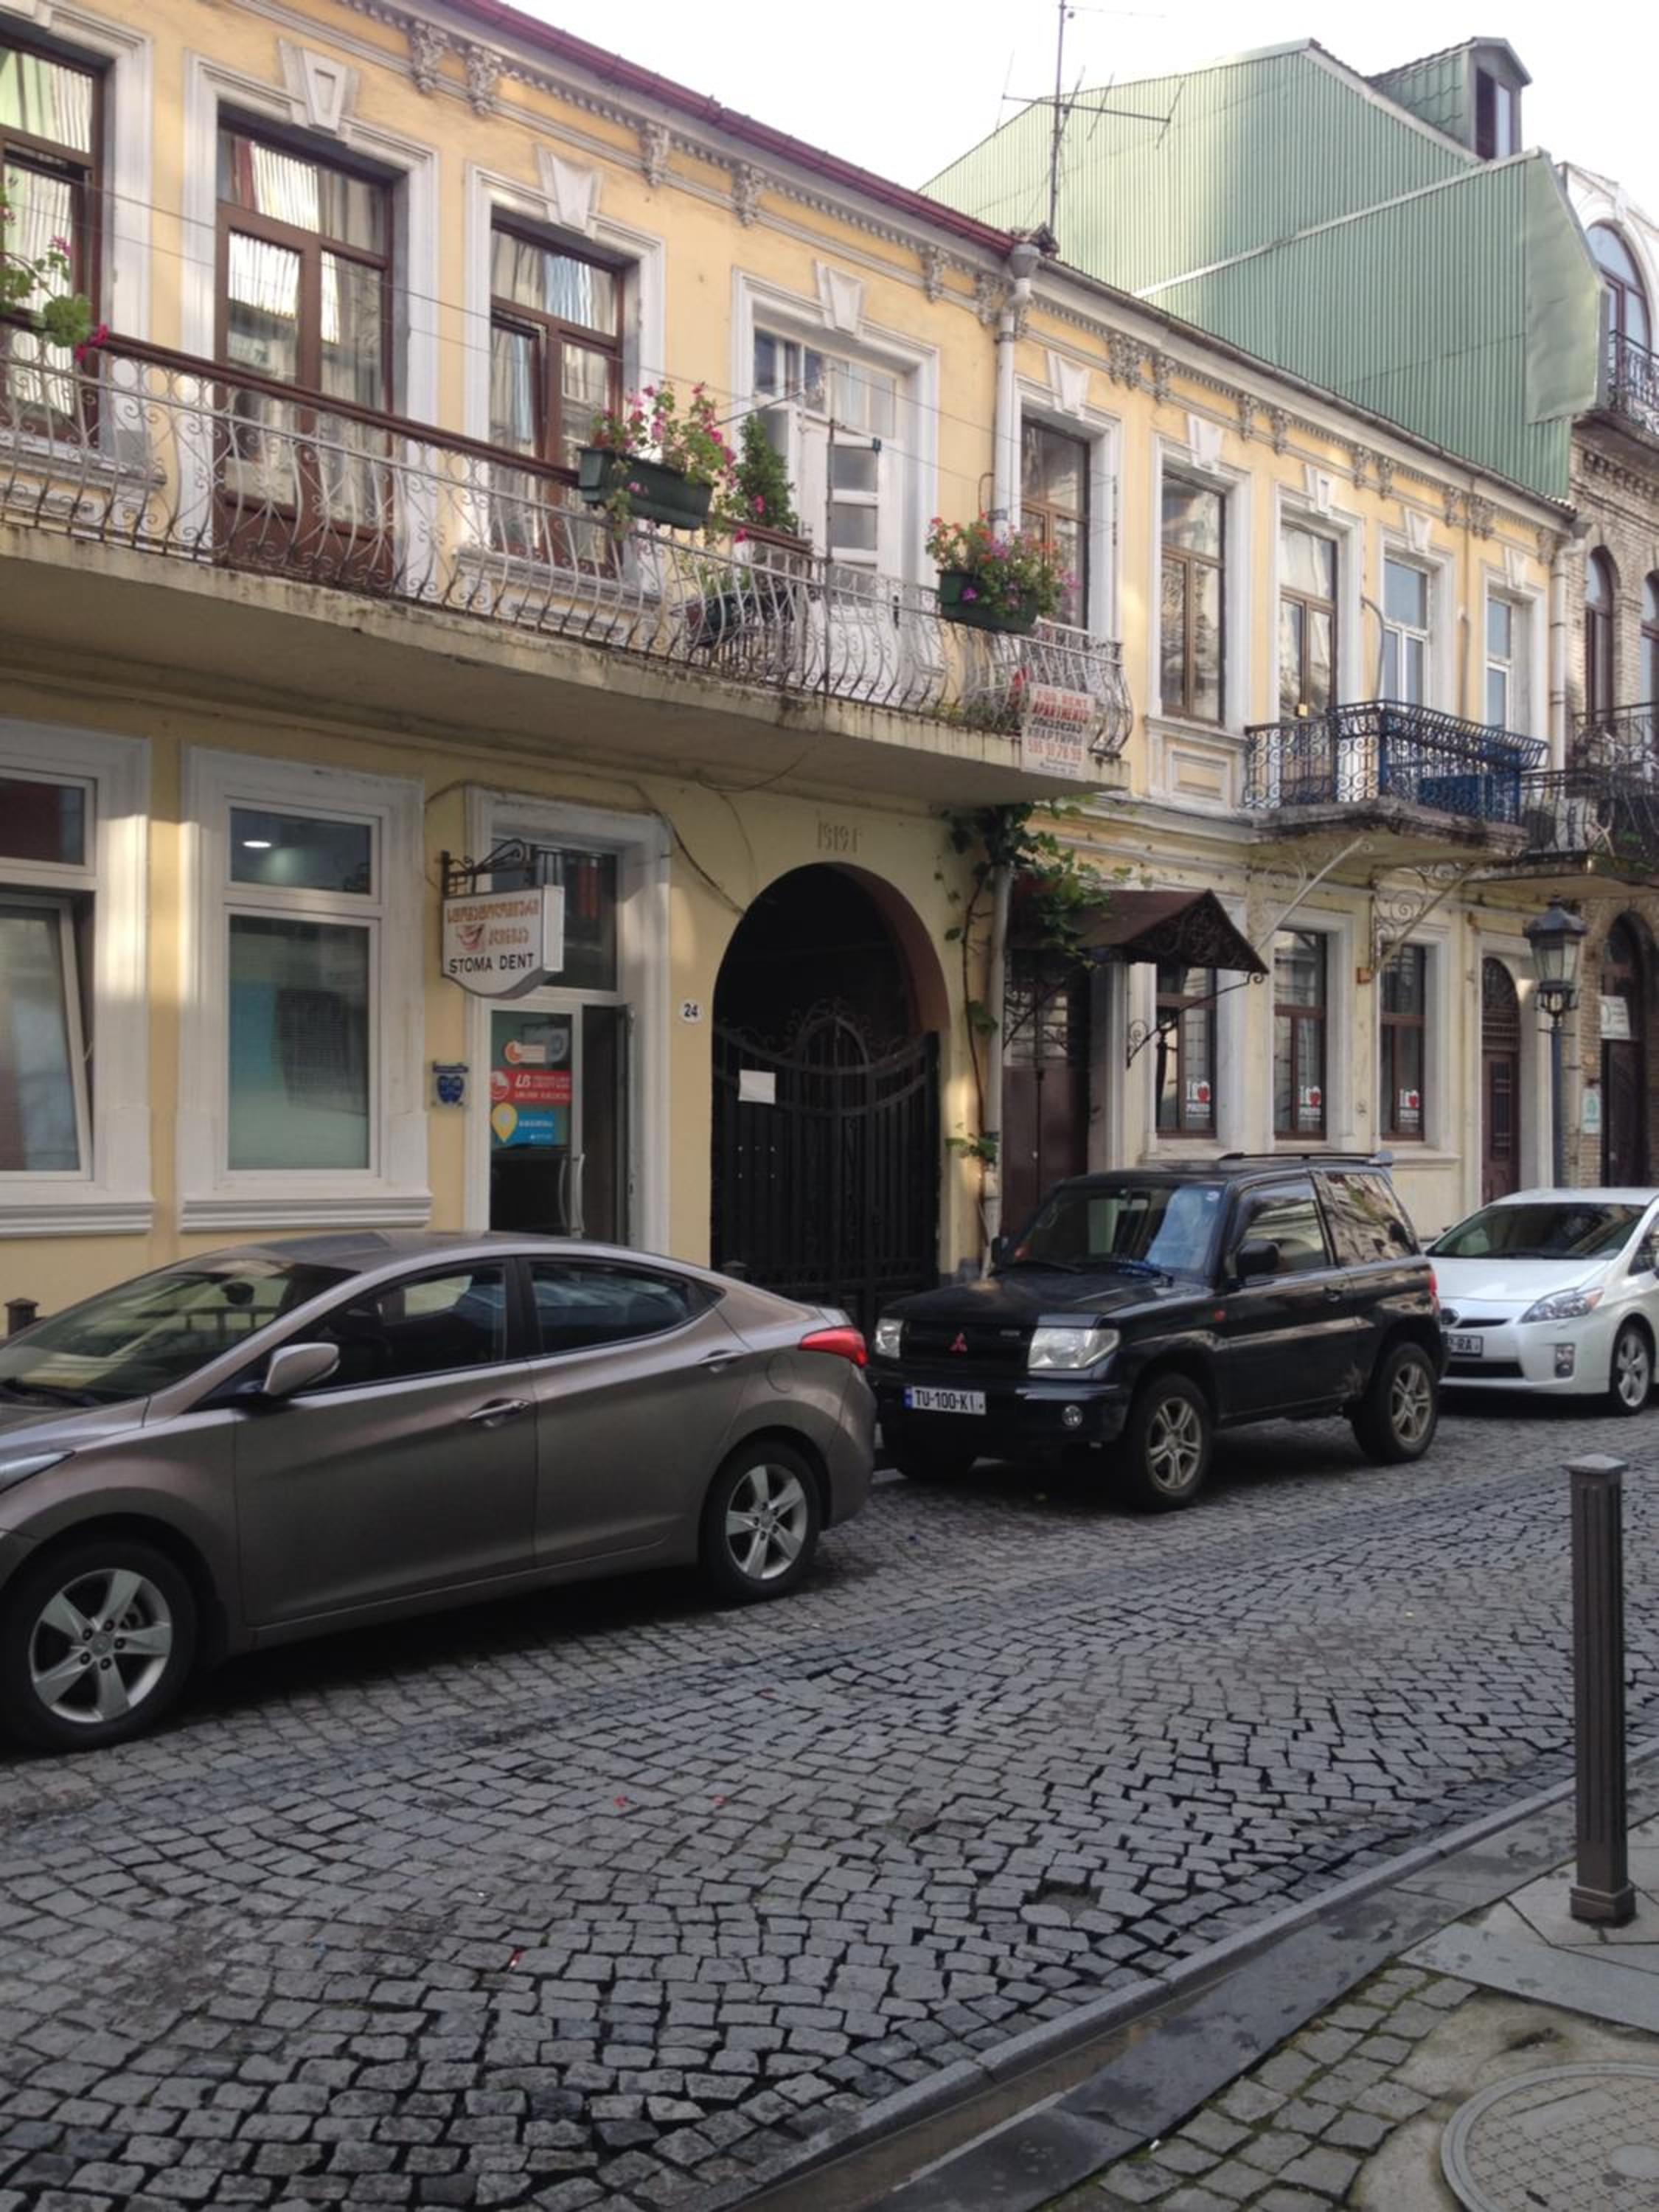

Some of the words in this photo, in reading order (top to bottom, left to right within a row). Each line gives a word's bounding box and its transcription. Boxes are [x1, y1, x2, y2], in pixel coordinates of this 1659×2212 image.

[448, 956, 493, 974] STOMA
[499, 952, 534, 970] DENT
[684, 1002, 698, 1018] 24
[915, 1389, 975, 1411] TU-100-KI
